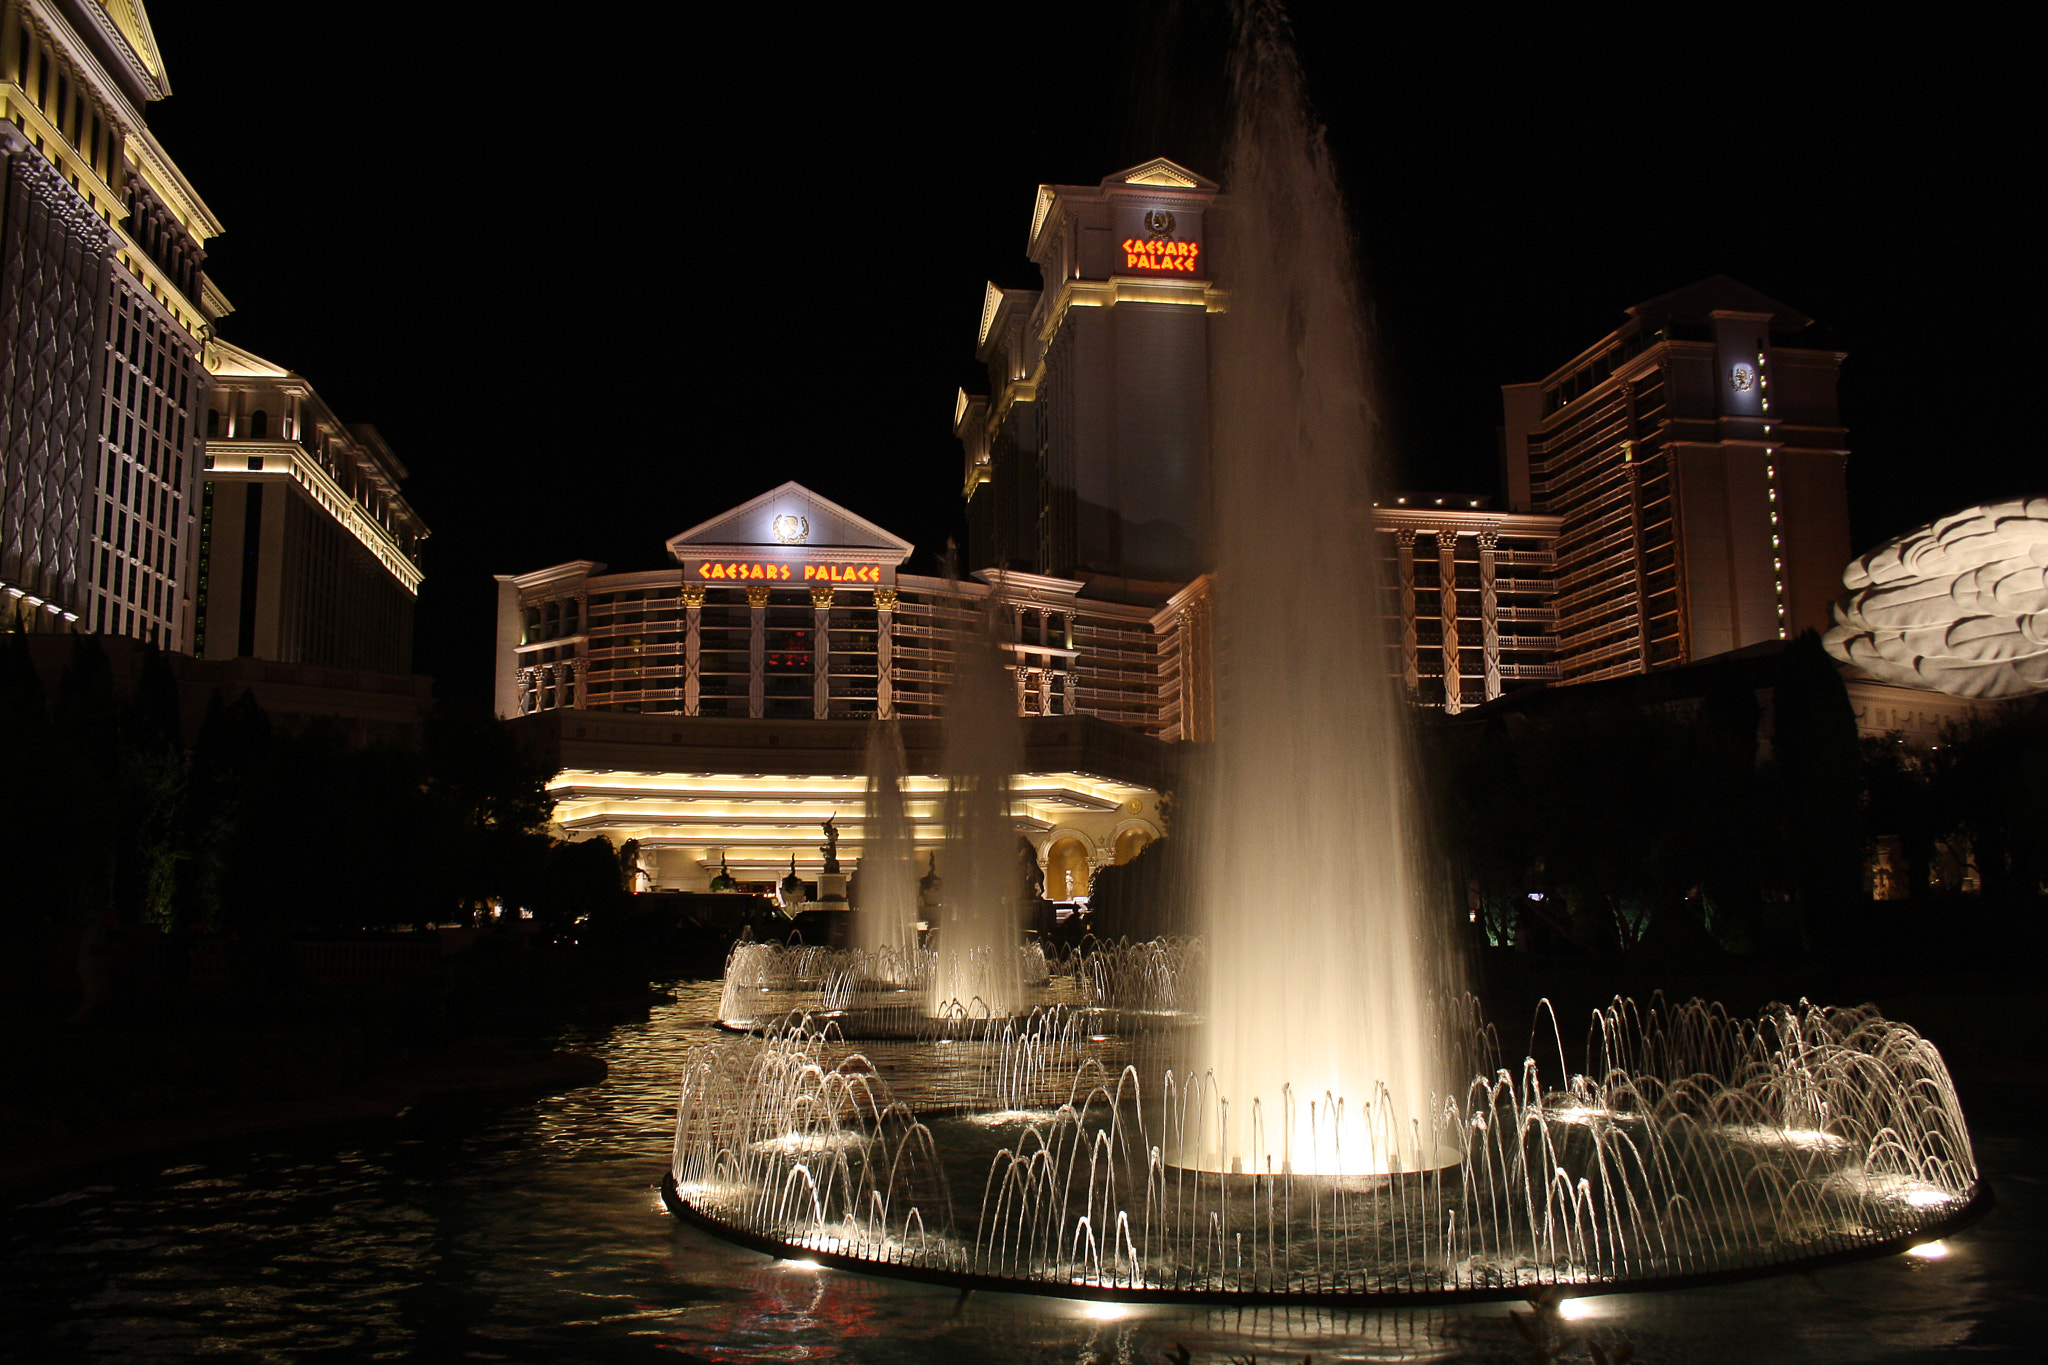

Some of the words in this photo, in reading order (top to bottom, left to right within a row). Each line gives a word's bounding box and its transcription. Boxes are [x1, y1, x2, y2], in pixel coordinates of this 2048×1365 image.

[1122, 239, 1199, 257] CAESARS
[1127, 254, 1195, 272] PALACE
[698, 562, 791, 580] CAESARS
[804, 564, 881, 582] PALACE
